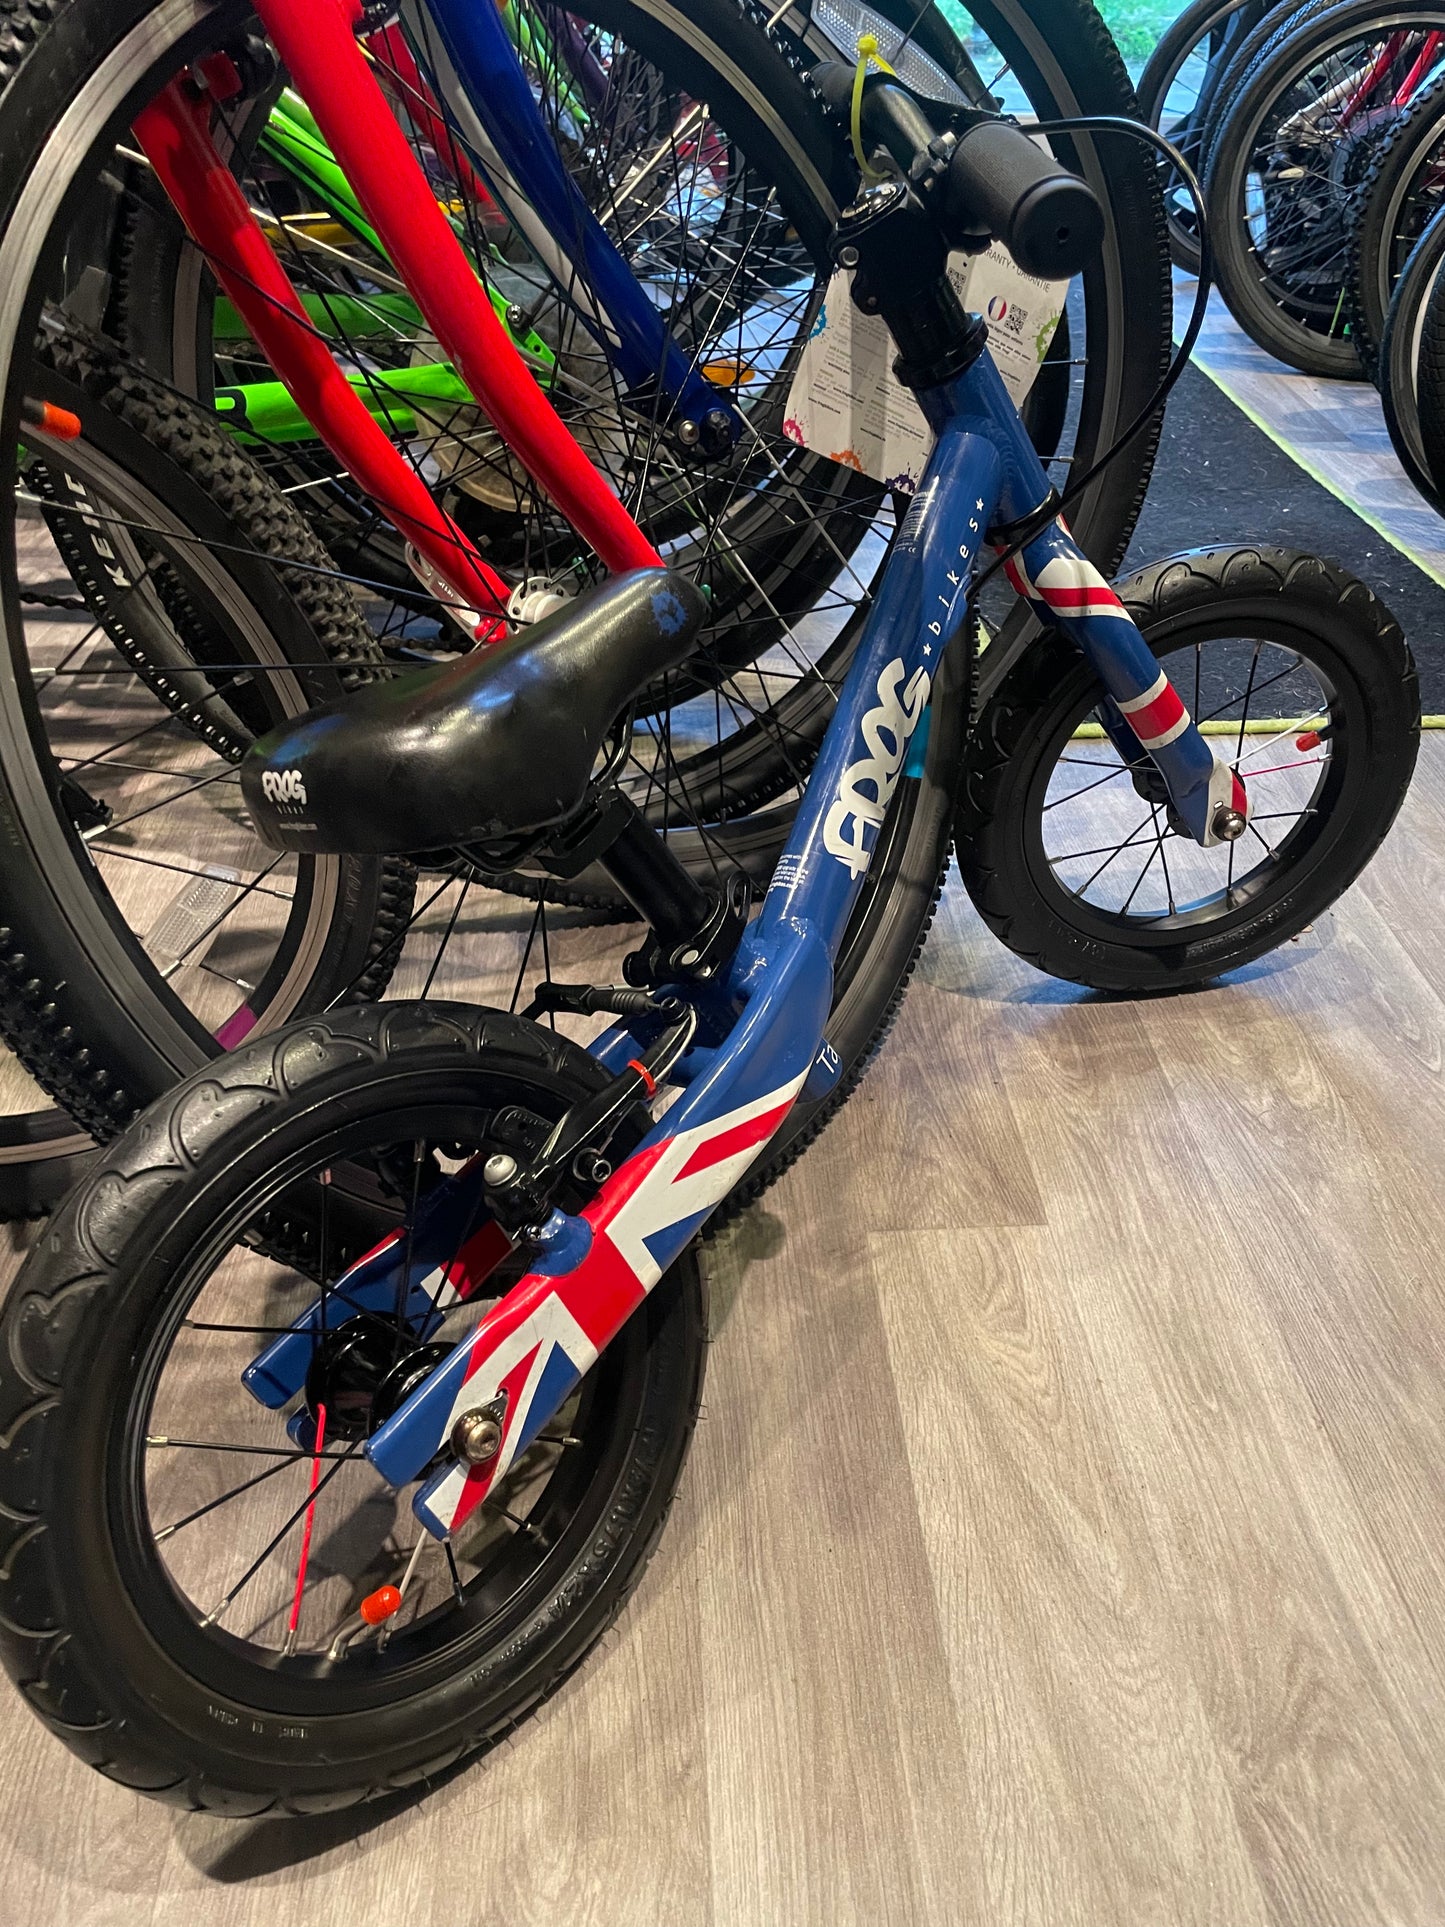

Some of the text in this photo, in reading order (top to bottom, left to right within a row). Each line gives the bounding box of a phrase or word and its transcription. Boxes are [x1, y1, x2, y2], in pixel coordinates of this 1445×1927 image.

[984, 249, 1011, 269] RANTY
[927, 517, 979, 637] bikes
[262, 769, 307, 805] FROG
[823, 657, 932, 881] FROG
[815, 1044, 839, 1074] Ta
